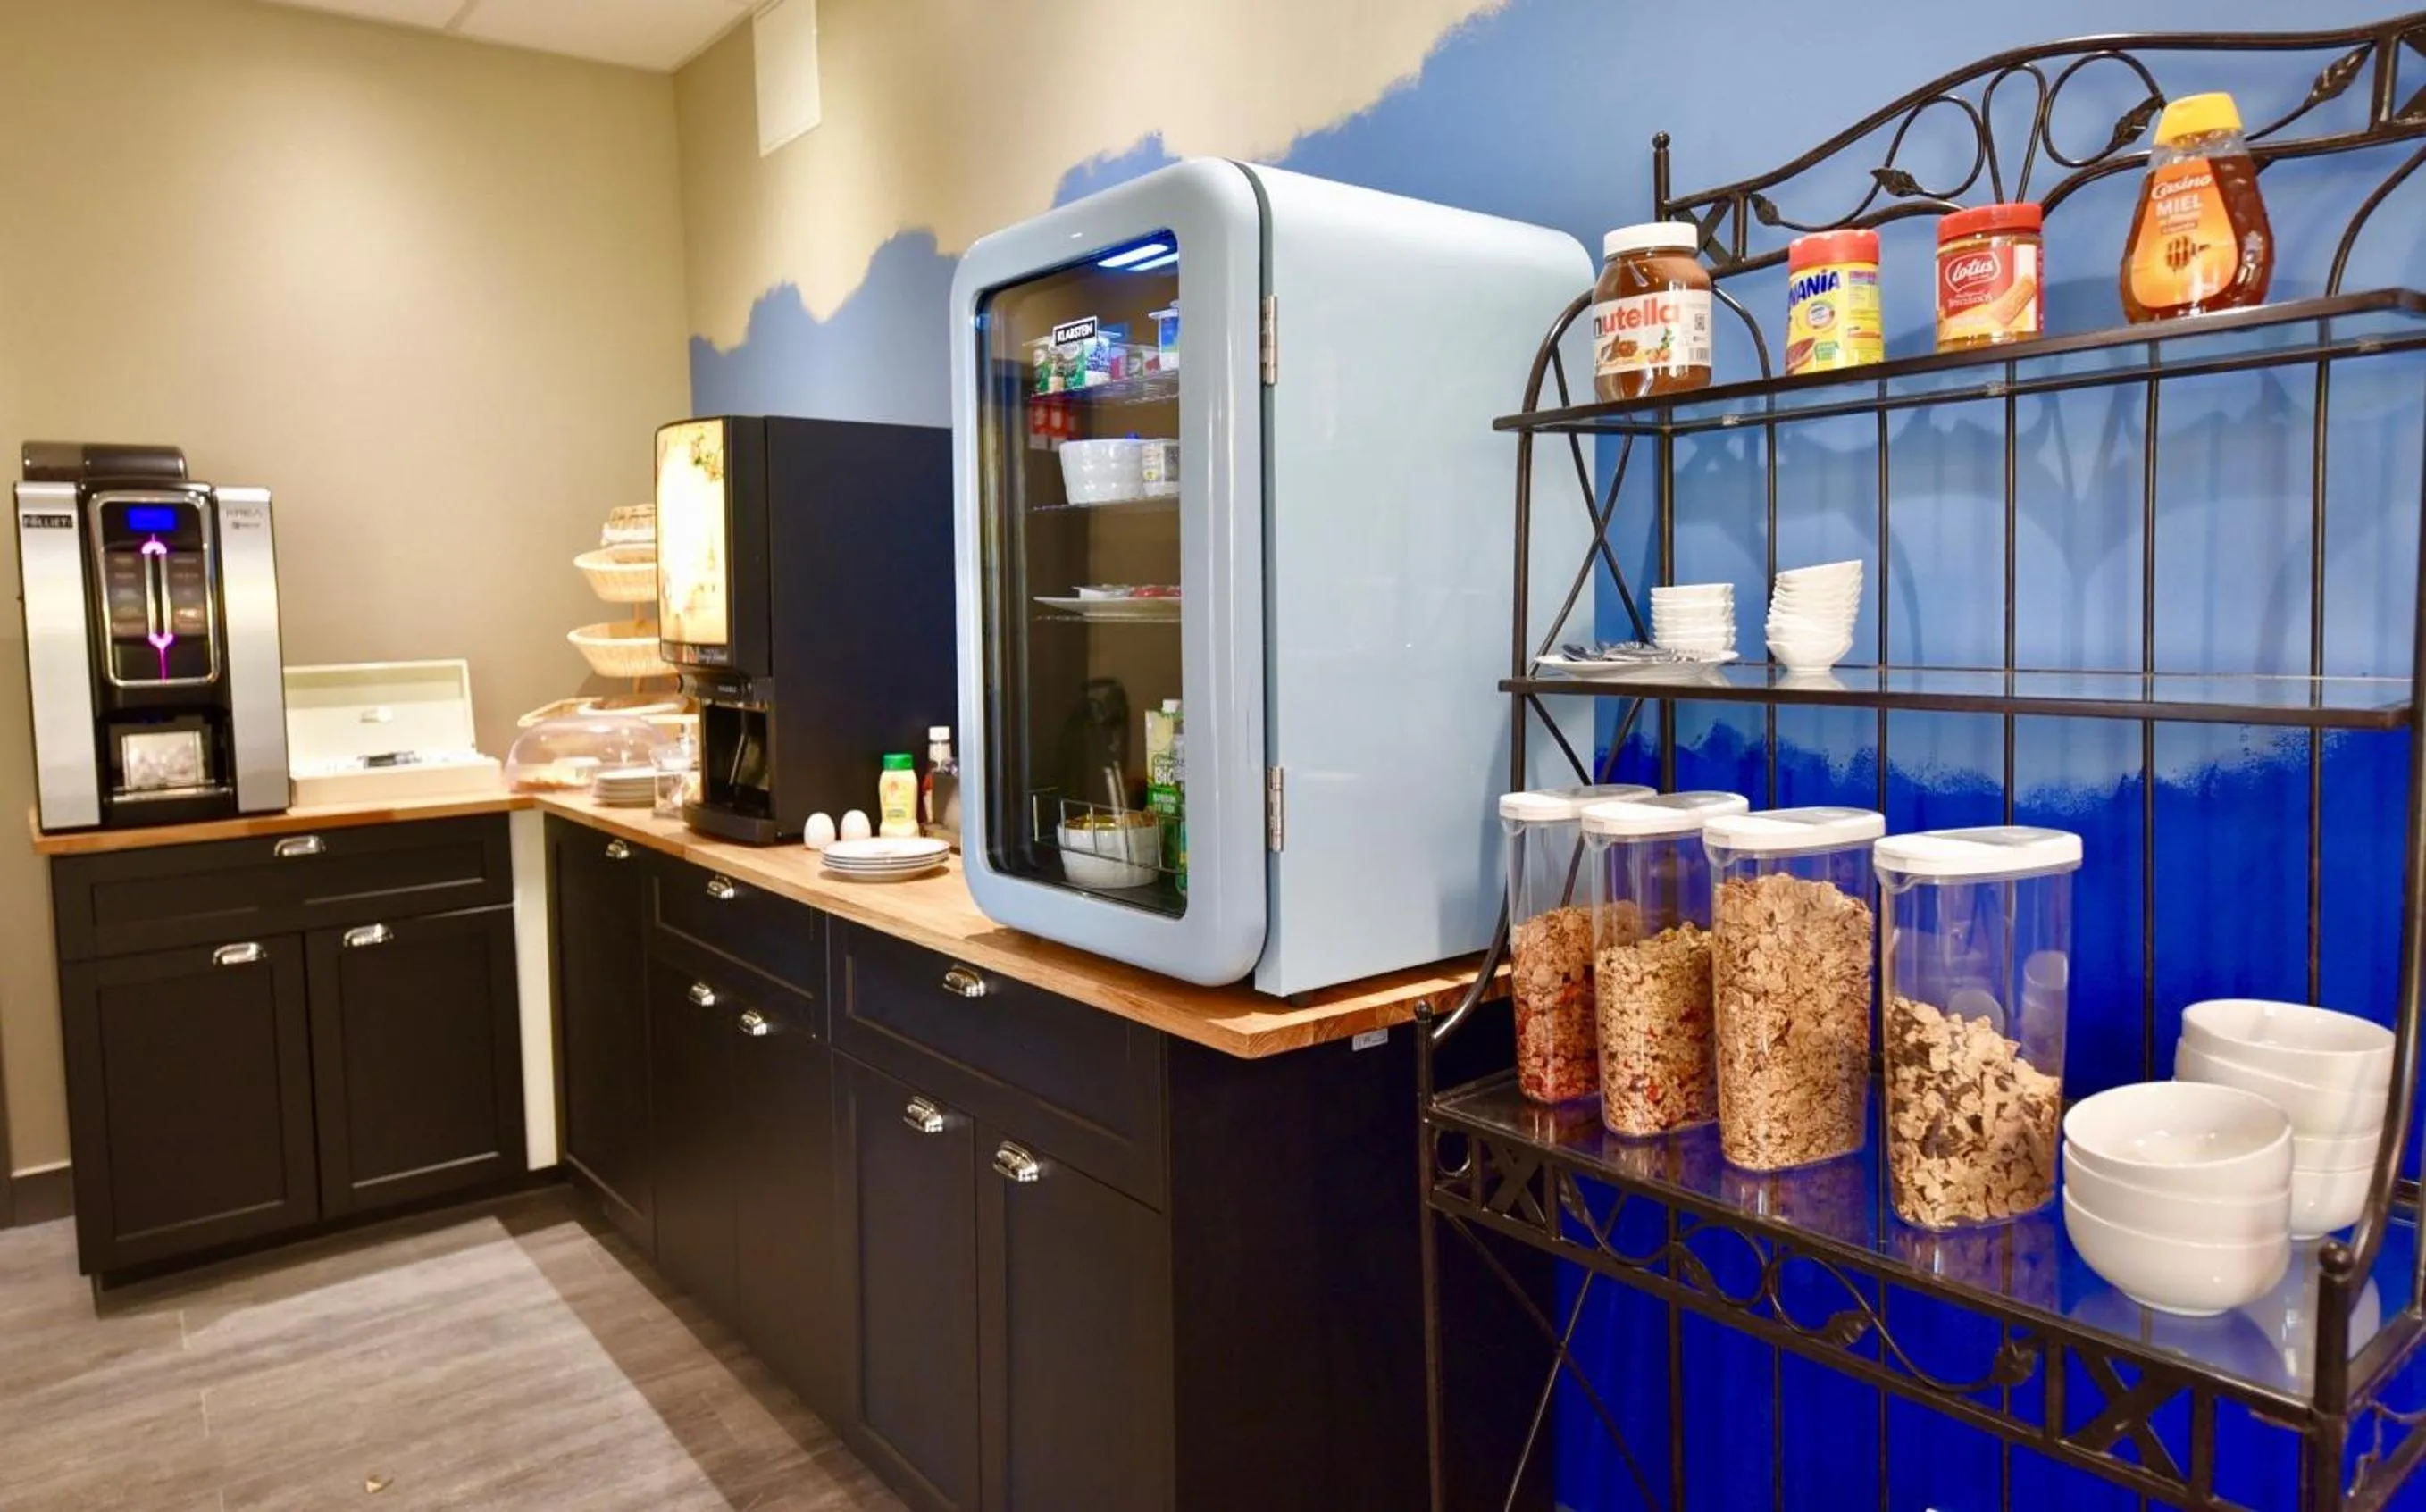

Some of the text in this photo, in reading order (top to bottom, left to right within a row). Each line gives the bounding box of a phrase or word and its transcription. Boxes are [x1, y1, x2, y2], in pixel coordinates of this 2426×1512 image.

[2151, 174, 2213, 200] Casino
[2157, 193, 2201, 217] MIEL
[1594, 297, 1679, 338] nutella
